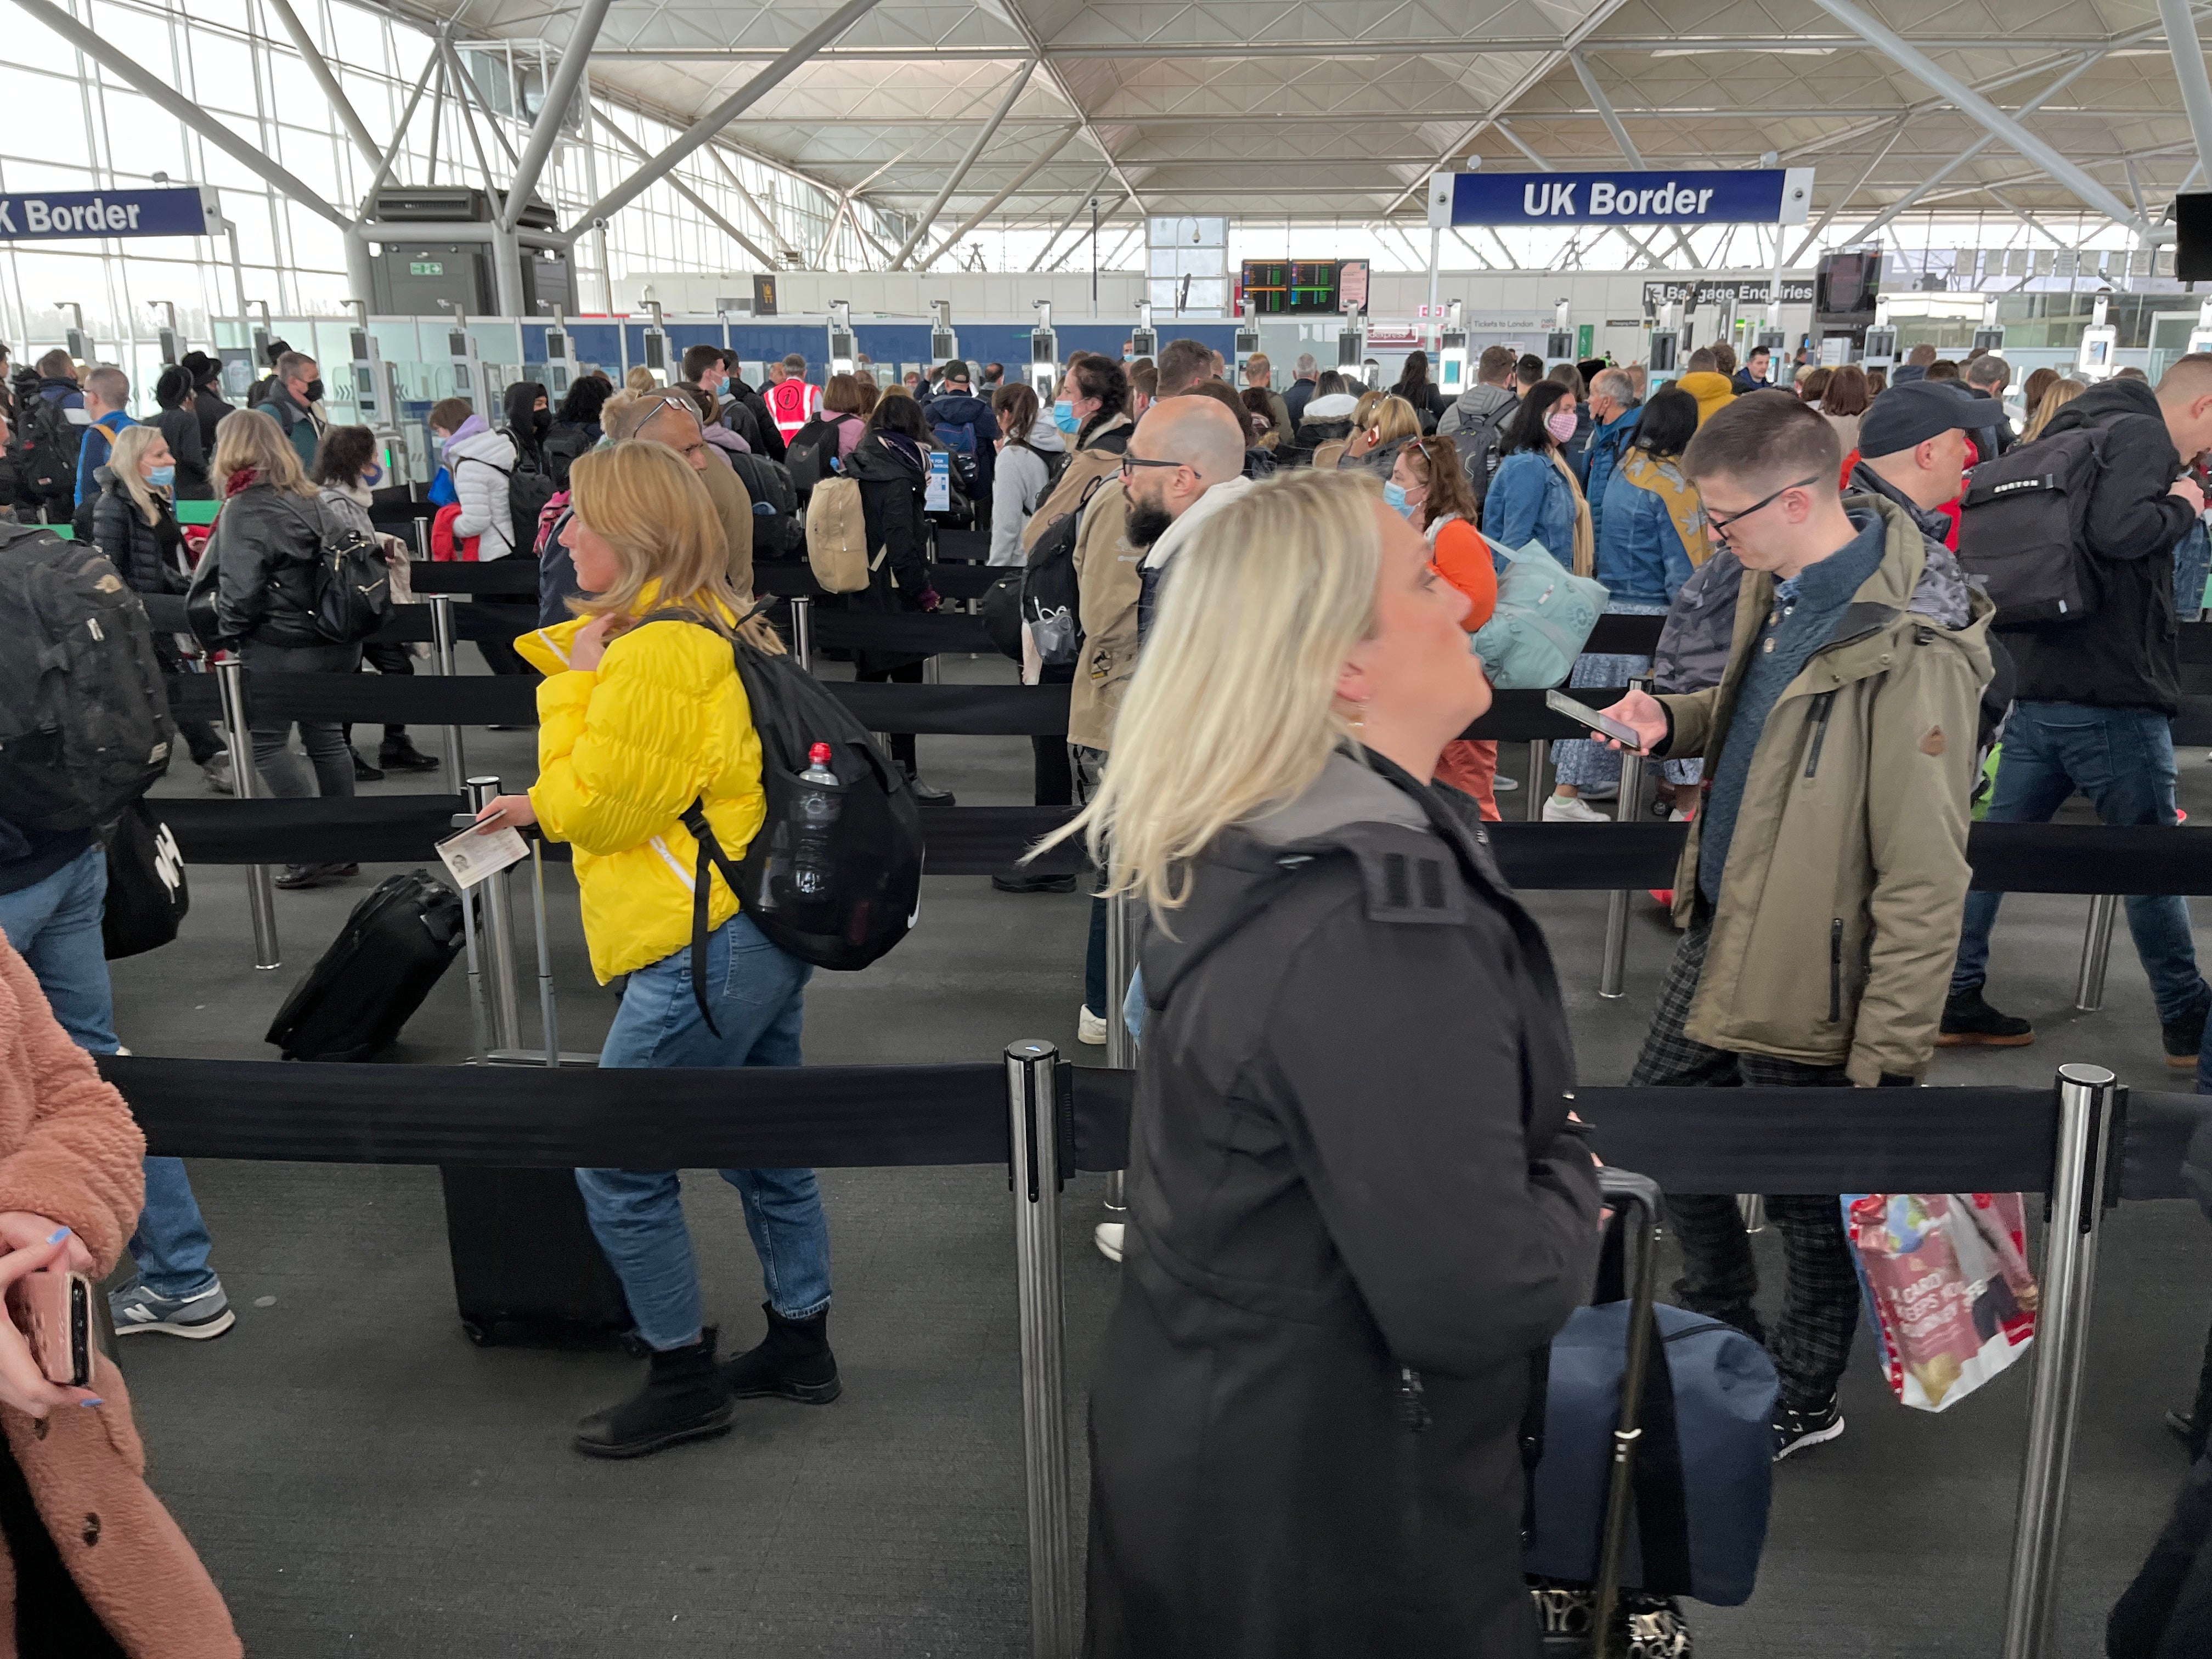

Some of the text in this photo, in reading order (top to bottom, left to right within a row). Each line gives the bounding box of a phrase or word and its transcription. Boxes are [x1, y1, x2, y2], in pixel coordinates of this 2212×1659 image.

[24, 198, 140, 233] Border
[1523, 181, 1713, 216] UK Border
[1667, 285, 1814, 304] Bagage Enqiries
